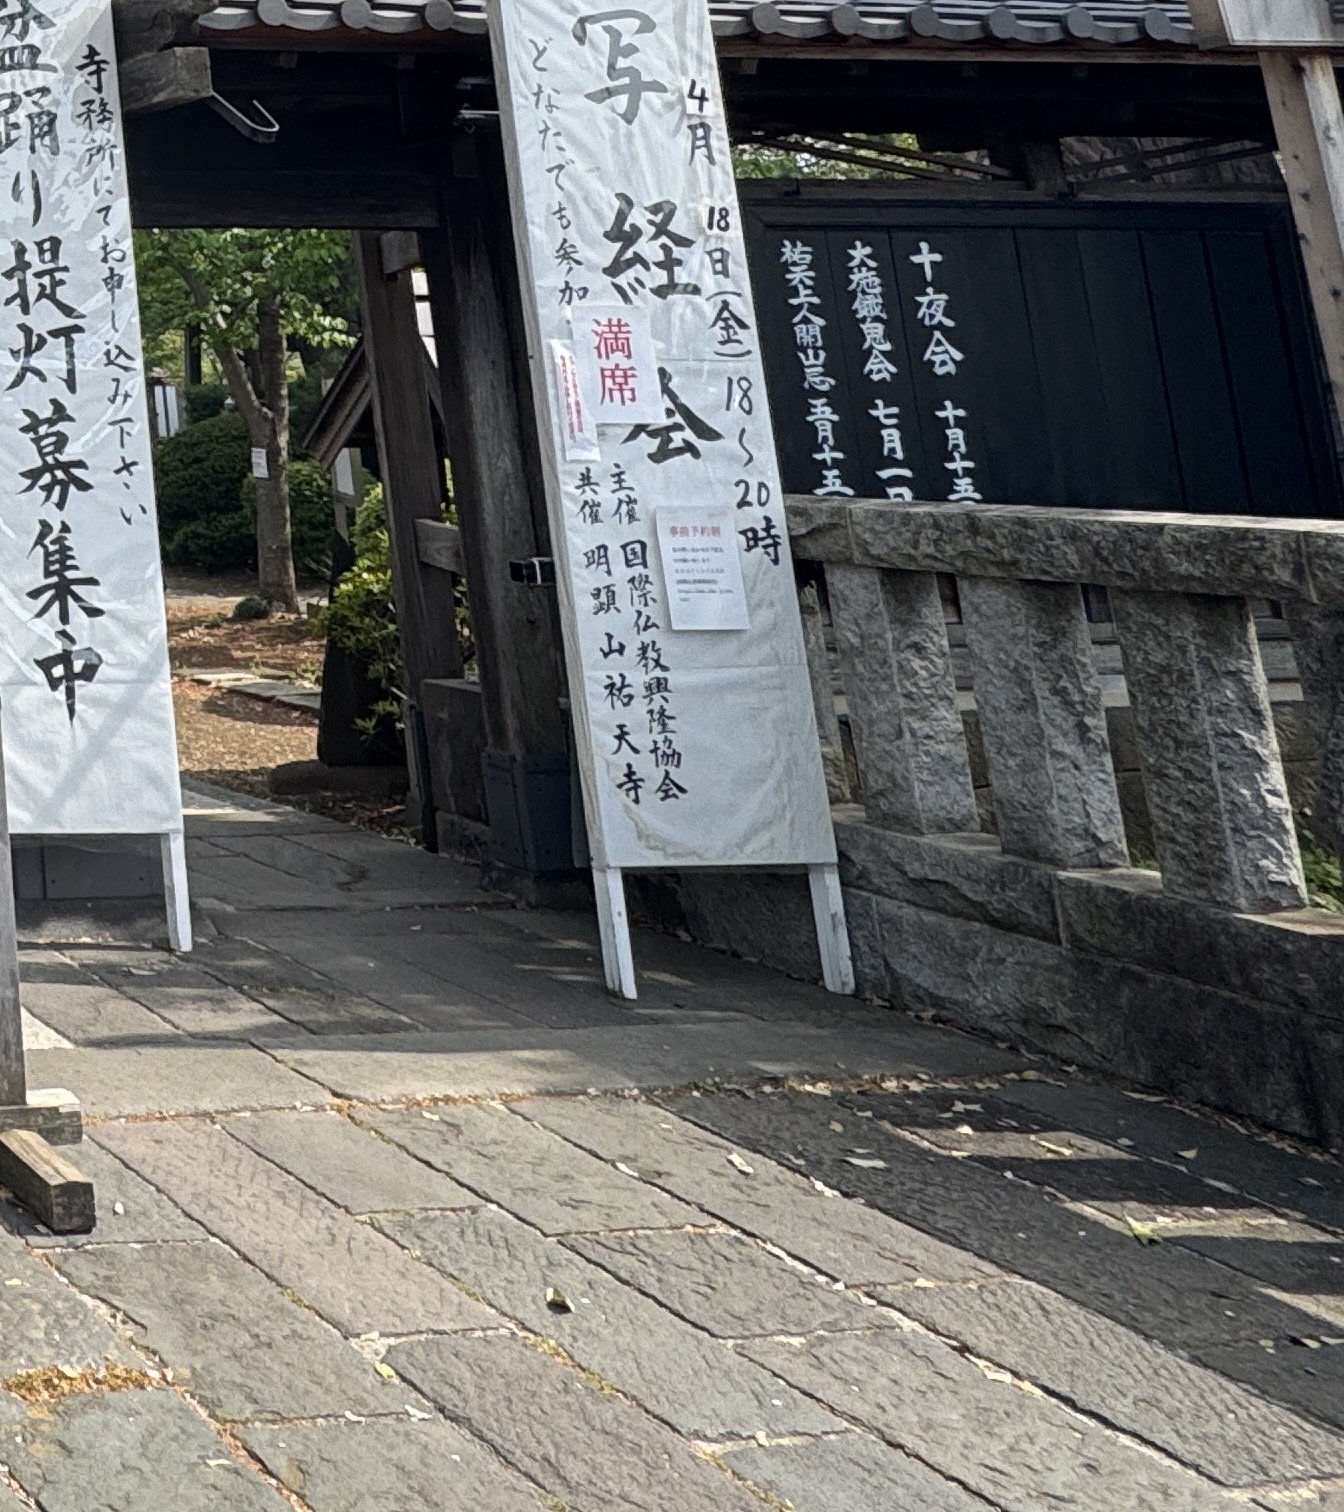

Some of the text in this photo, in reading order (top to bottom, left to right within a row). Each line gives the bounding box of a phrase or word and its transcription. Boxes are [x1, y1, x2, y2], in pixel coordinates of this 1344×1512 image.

[528, 36, 590, 326] どなたでも参加
[572, 8, 724, 464] 写経会
[574, 466, 604, 525] 共催
[591, 317, 638, 406] 満席
[908, 240, 984, 505] 十夜会 十月十五
[610, 462, 689, 802] 主催 国際仏教興隆協会
